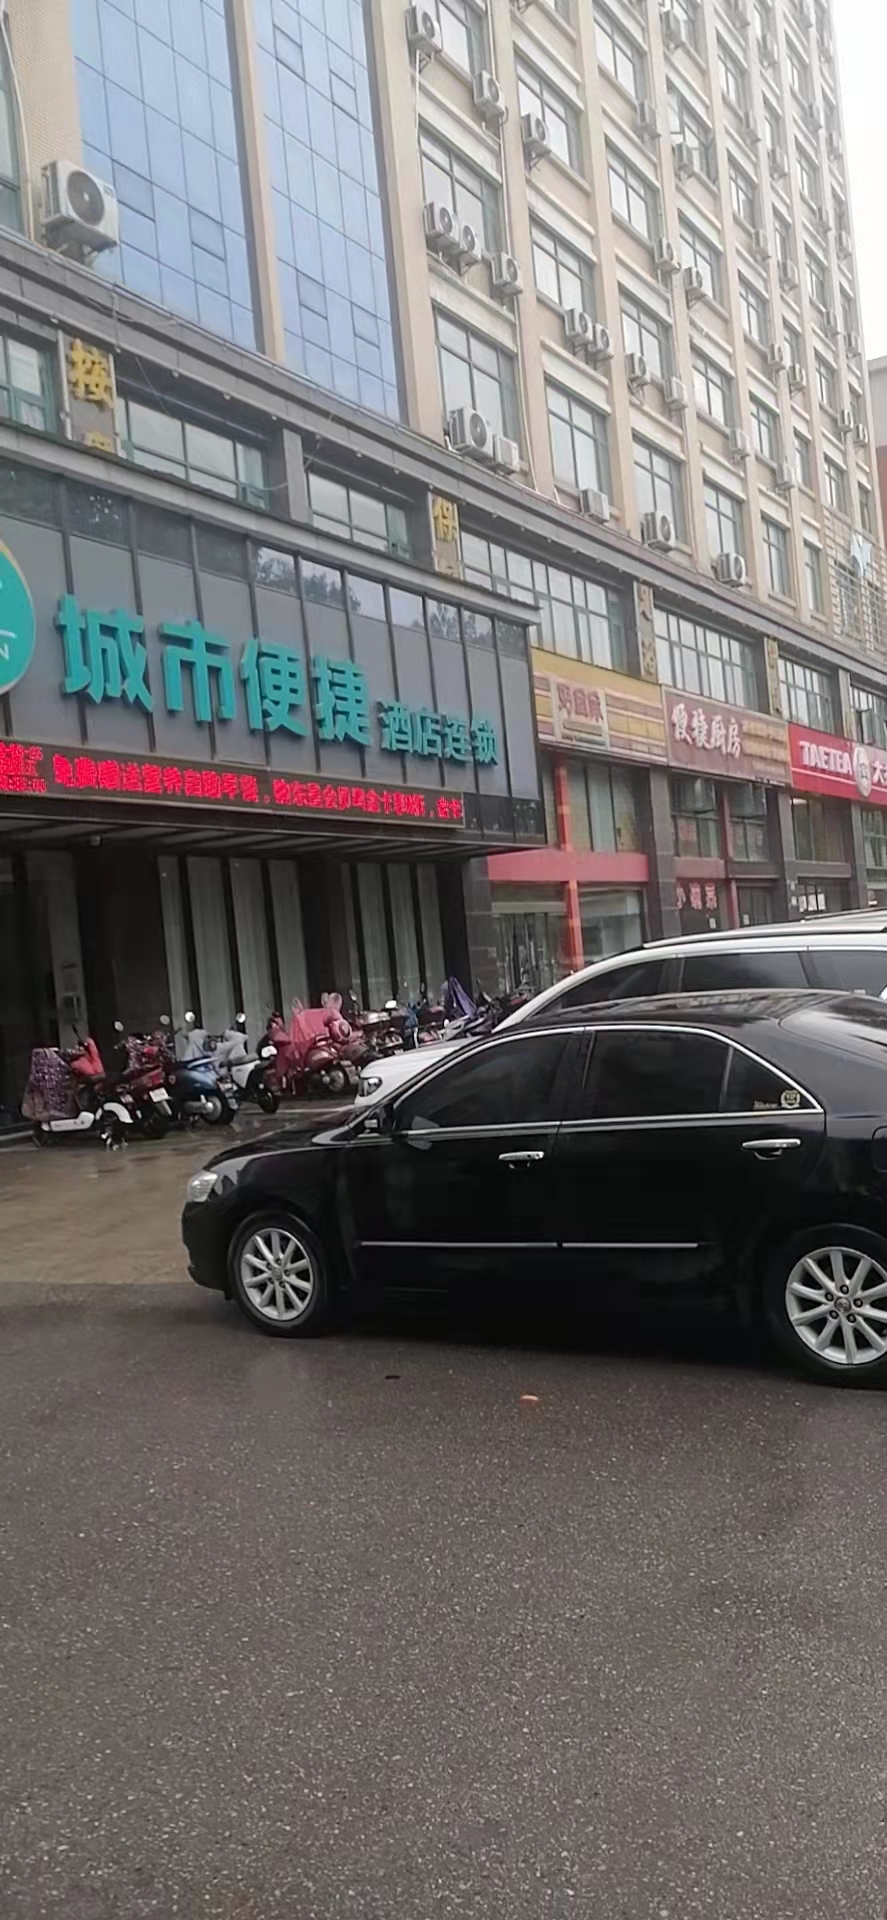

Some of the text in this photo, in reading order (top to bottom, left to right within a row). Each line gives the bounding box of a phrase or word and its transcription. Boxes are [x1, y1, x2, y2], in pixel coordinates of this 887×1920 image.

[56, 594, 498, 766] 城市便捷 酒店连锁
[799, 741, 853, 776] TAETEA
[872, 760, 887, 787] 大
